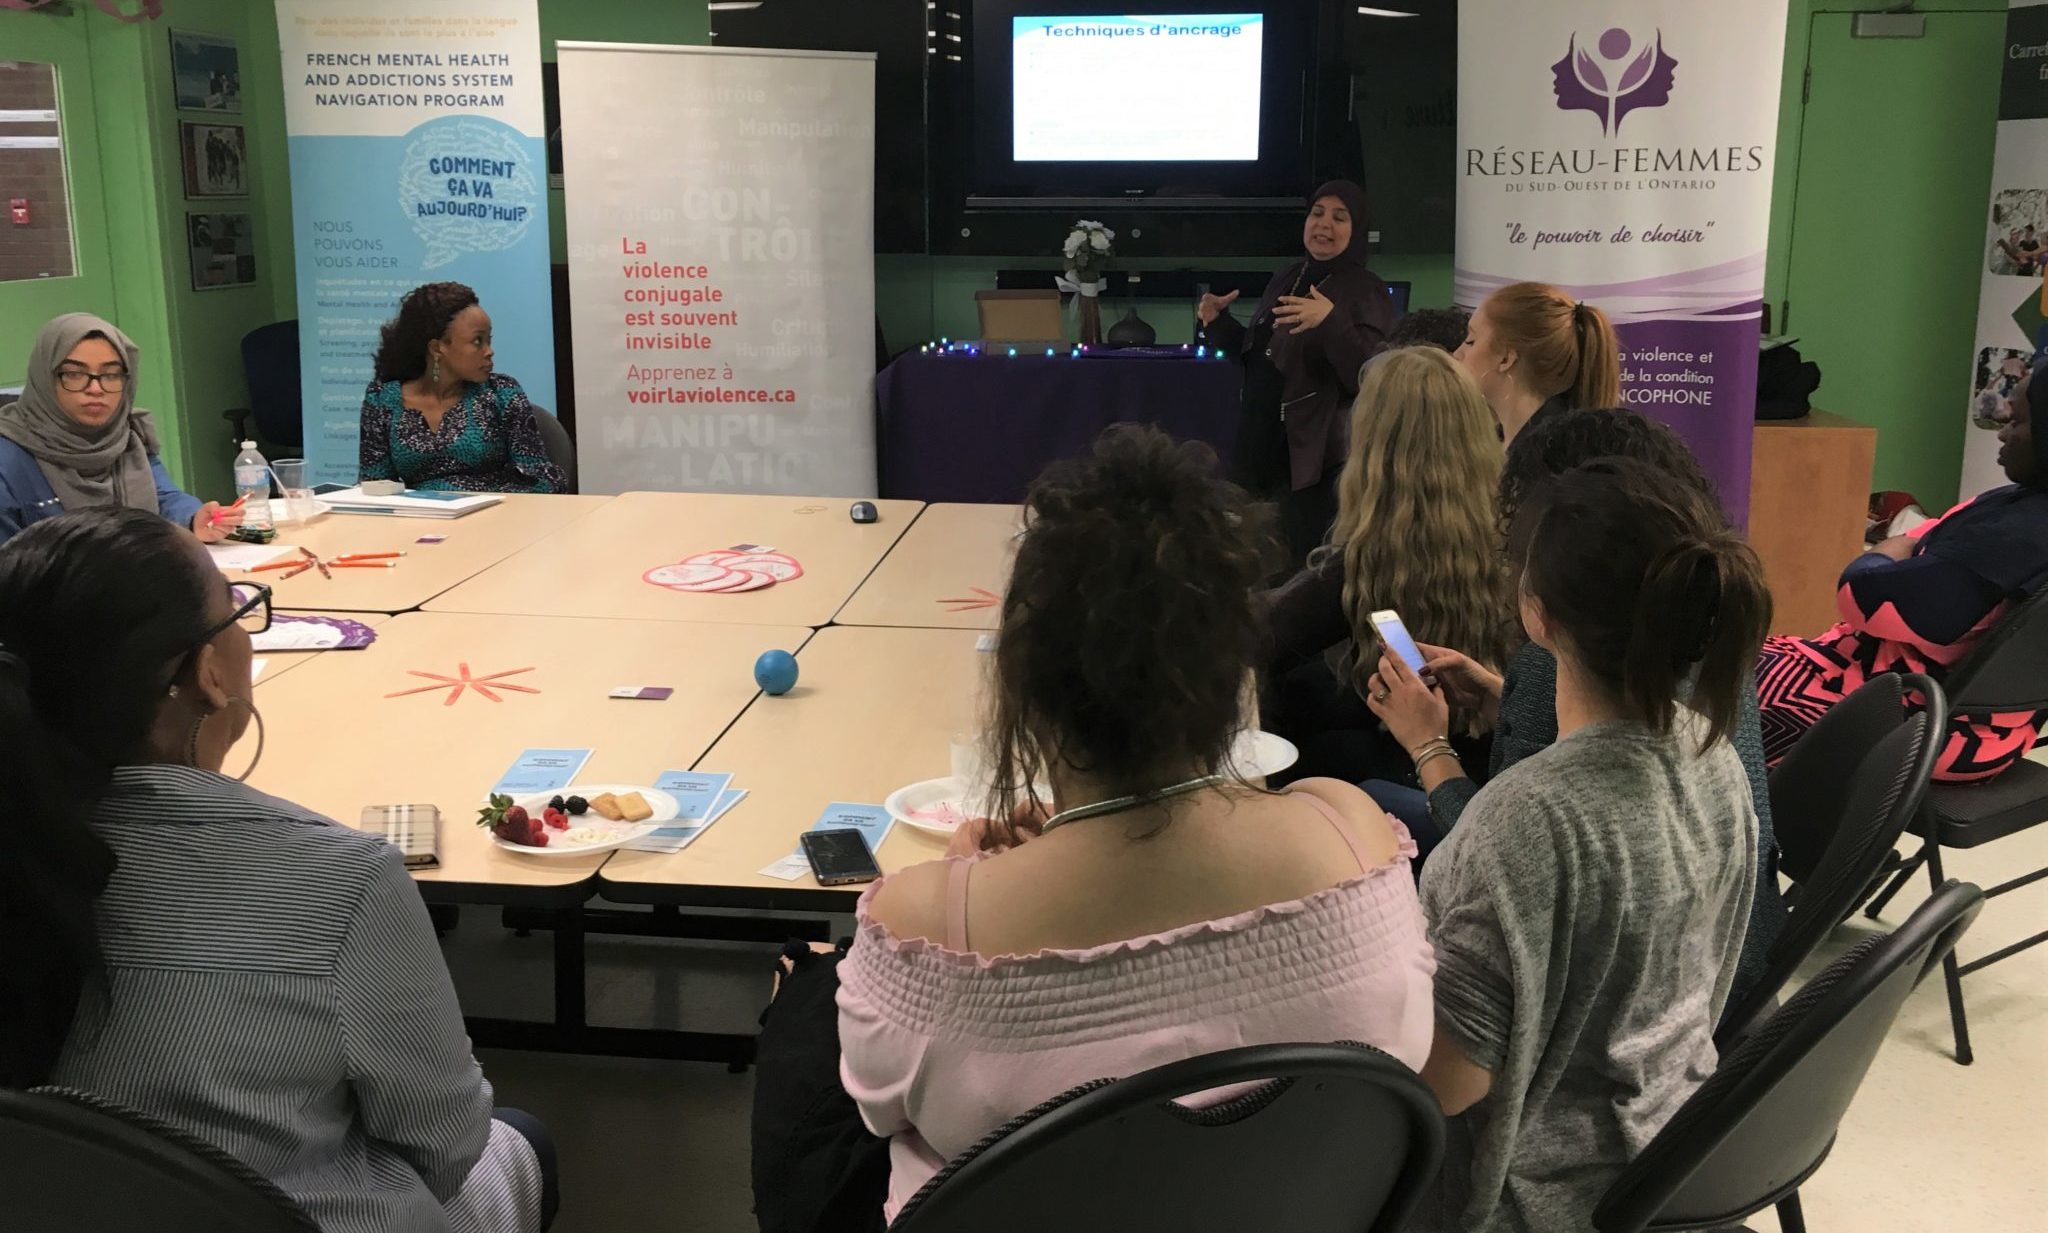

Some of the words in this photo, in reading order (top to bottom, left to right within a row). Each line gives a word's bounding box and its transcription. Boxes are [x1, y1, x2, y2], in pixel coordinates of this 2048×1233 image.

[1042, 24, 1145, 39] Techniques
[1149, 23, 1242, 38] d'ancrage
[306, 53, 371, 67] FRENCH
[377, 53, 443, 67] MENTAL
[448, 53, 510, 67] HEALTH
[304, 73, 340, 87] AND
[346, 73, 447, 87] ADDICTIONS
[452, 73, 514, 87] SYSTEM
[315, 93, 419, 107] NAVIGATION
[423, 93, 505, 107] PROGRAM
[429, 156, 516, 179] COMMENT
[1465, 145, 1764, 177] RÉSEAU-FEMMES
[447, 177, 469, 197] ÇA
[472, 179, 494, 199] VA
[1505, 182, 1524, 193] DU
[1613, 180, 1631, 191] DE
[313, 220, 354, 233] NOUS
[314, 238, 384, 251] POUVONS
[622, 236, 647, 255] La
[1532, 229, 1603, 251] pouvoir
[1610, 224, 1634, 244] de
[314, 256, 353, 269] VOUS
[356, 256, 399, 269] AIDER
[622, 261, 708, 280] violence
[623, 285, 723, 306] conjugale
[624, 310, 655, 327] est
[660, 310, 738, 327] souvent
[626, 332, 712, 350] invisible
[1632, 346, 1694, 362] violence
[1699, 351, 1713, 364] et
[626, 364, 716, 384] Apprenez
[722, 363, 733, 380] à
[1619, 367, 1635, 382] de
[1639, 367, 1652, 382] la
[1655, 368, 1714, 385] condition
[627, 386, 796, 405] voirlaviolence.ca
